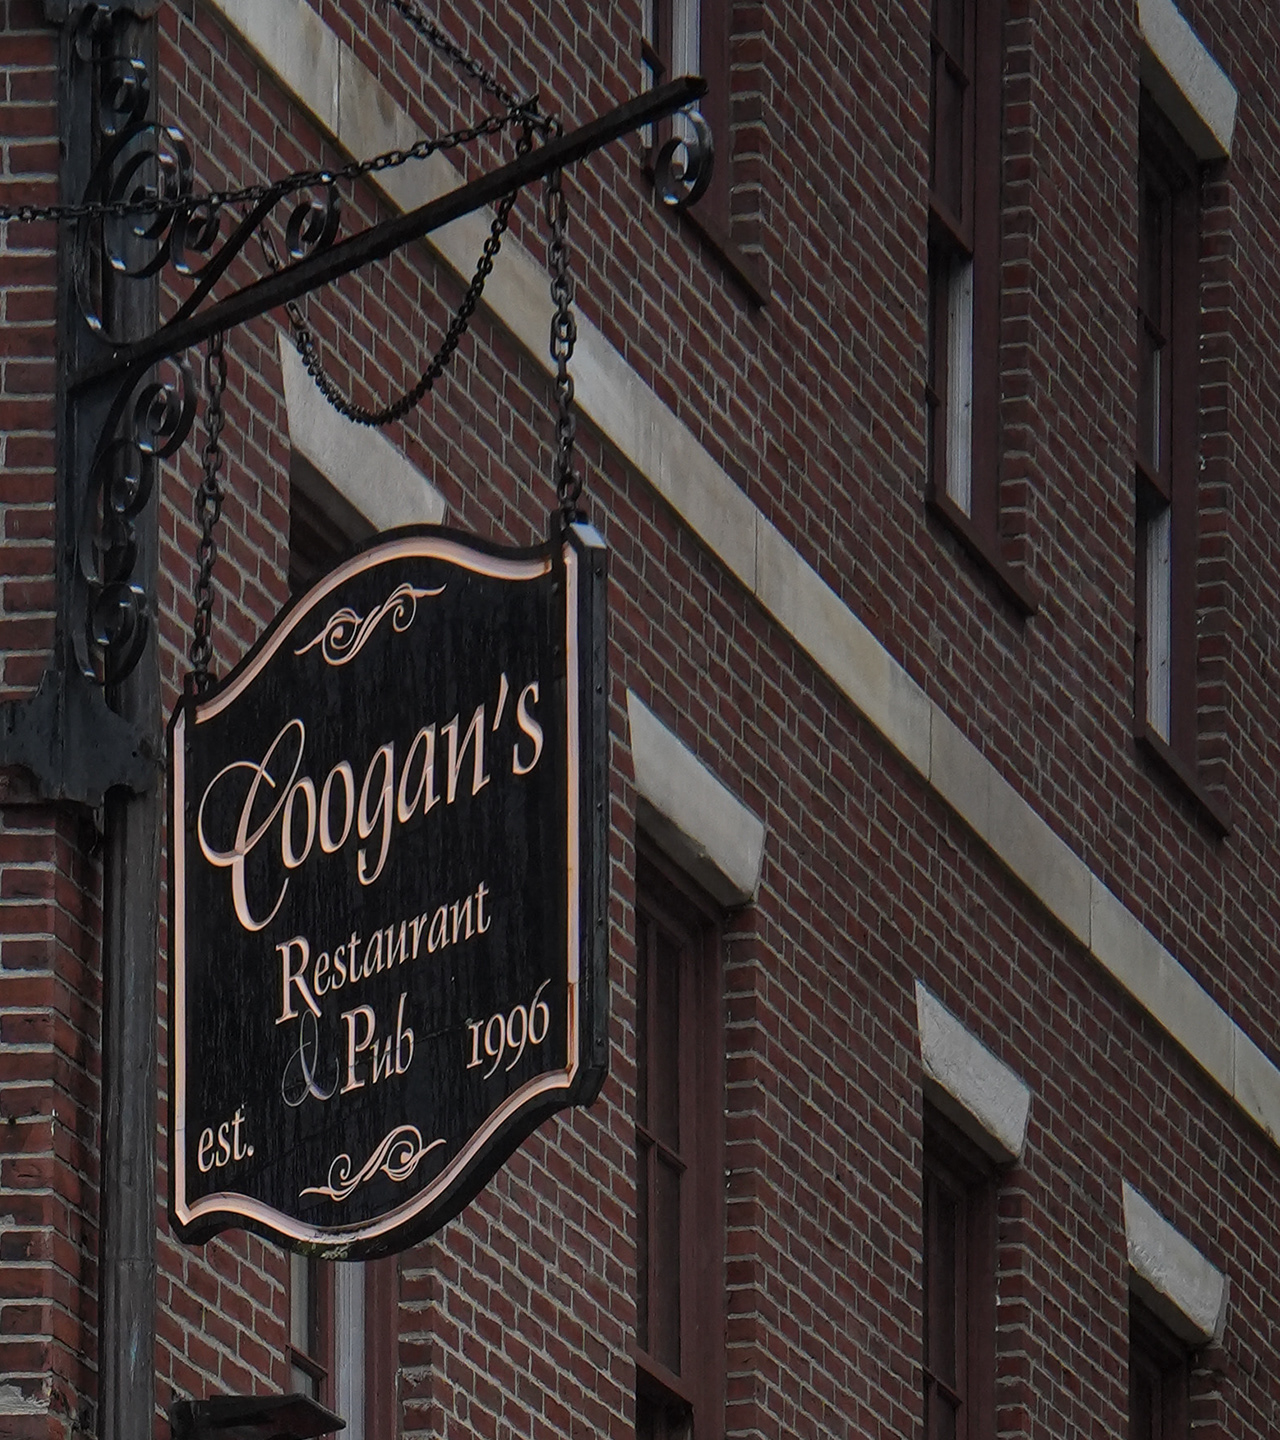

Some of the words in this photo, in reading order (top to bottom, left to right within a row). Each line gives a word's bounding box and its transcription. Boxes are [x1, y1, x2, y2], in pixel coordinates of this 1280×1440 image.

[198, 672, 543, 931] Coogan's
[275, 880, 491, 1025] Restaurant
[197, 1104, 255, 1173] est.
[466, 979, 552, 1080] 1996
[340, 992, 414, 1096] Pub
